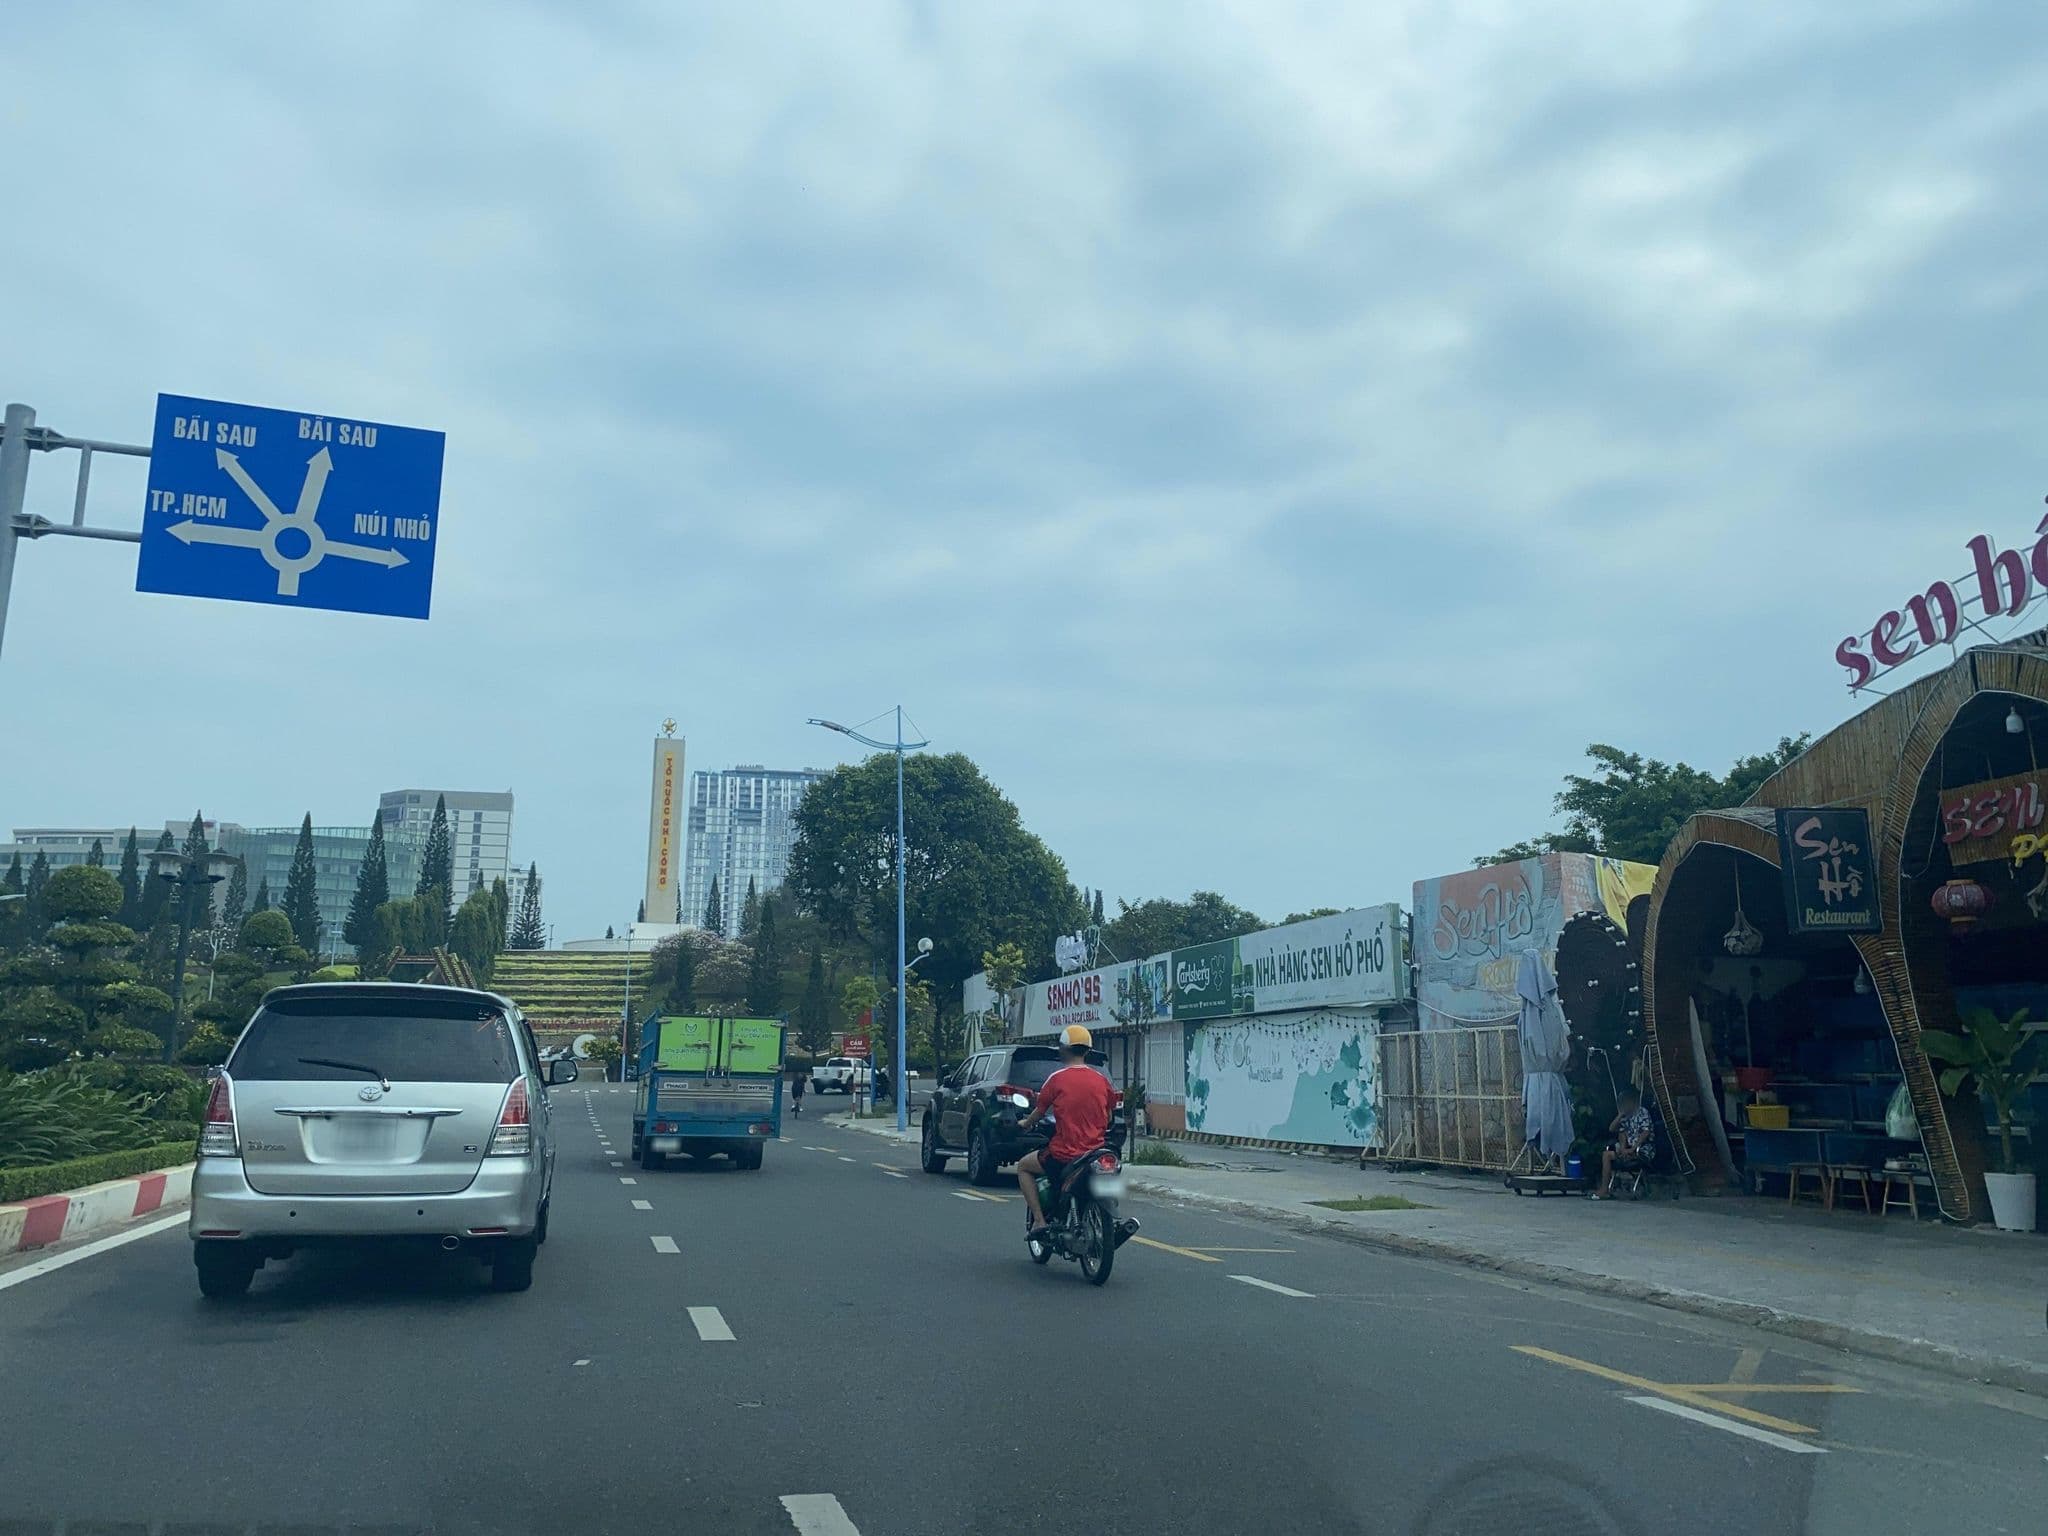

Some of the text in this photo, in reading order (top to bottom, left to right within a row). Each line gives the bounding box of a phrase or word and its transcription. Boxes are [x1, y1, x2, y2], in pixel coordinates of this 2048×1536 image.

[173, 415, 257, 447] BÃI SAU
[298, 415, 378, 448] BÃI SAU
[151, 490, 227, 519] TP.HCM
[354, 510, 431, 541] NÚI NHỎ
[1795, 816, 1860, 861] Sen
[1819, 856, 1864, 905] Hồ
[1805, 907, 1872, 925] Restaurant
[1256, 921, 1384, 988] NHÀ HÀNG SEN HỒ PHỐ
[1177, 958, 1210, 993] Carlsberg
